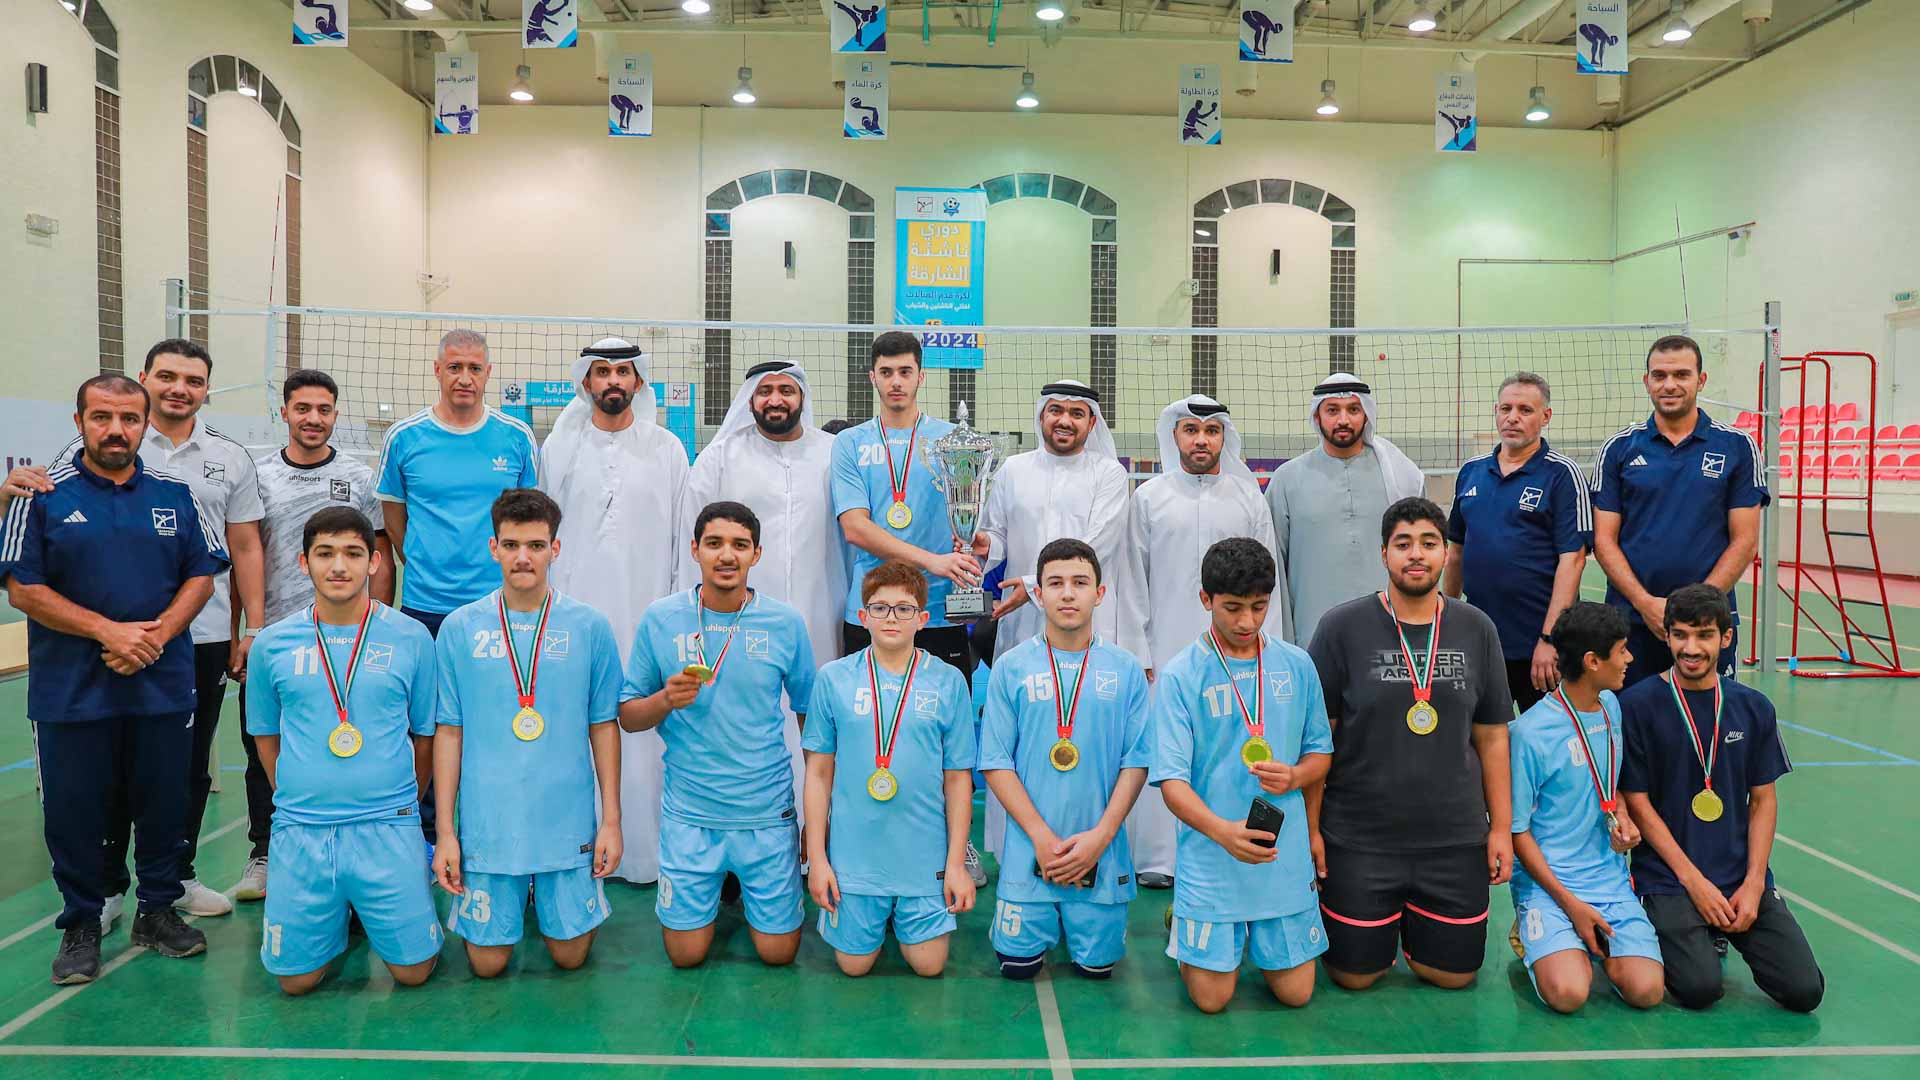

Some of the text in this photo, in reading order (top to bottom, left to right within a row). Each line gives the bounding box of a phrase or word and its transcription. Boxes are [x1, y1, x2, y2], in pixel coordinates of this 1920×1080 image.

[1587, 3, 1619, 13] السباحة
[870, 81, 882, 90] كرة
[1180, 87, 1219, 97] كرة الطاولة
[920, 223, 960, 240] دوري
[911, 241, 969, 258] ناشئة
[910, 264, 969, 284] الشارقة
[927, 333, 977, 348] 2024
[544, 383, 576, 396] شارقة
[858, 443, 886, 466] 20
[472, 630, 507, 658] 23
[672, 632, 704, 662] 19
[292, 645, 319, 675] 11
[1382, 667, 1464, 679] AROUR
[1022, 672, 1054, 703] 15
[854, 688, 872, 715] 5
[1203, 683, 1232, 717] 17
[1568, 736, 1587, 766] 8
[458, 888, 492, 923] 23
[1527, 908, 1544, 941] 8
